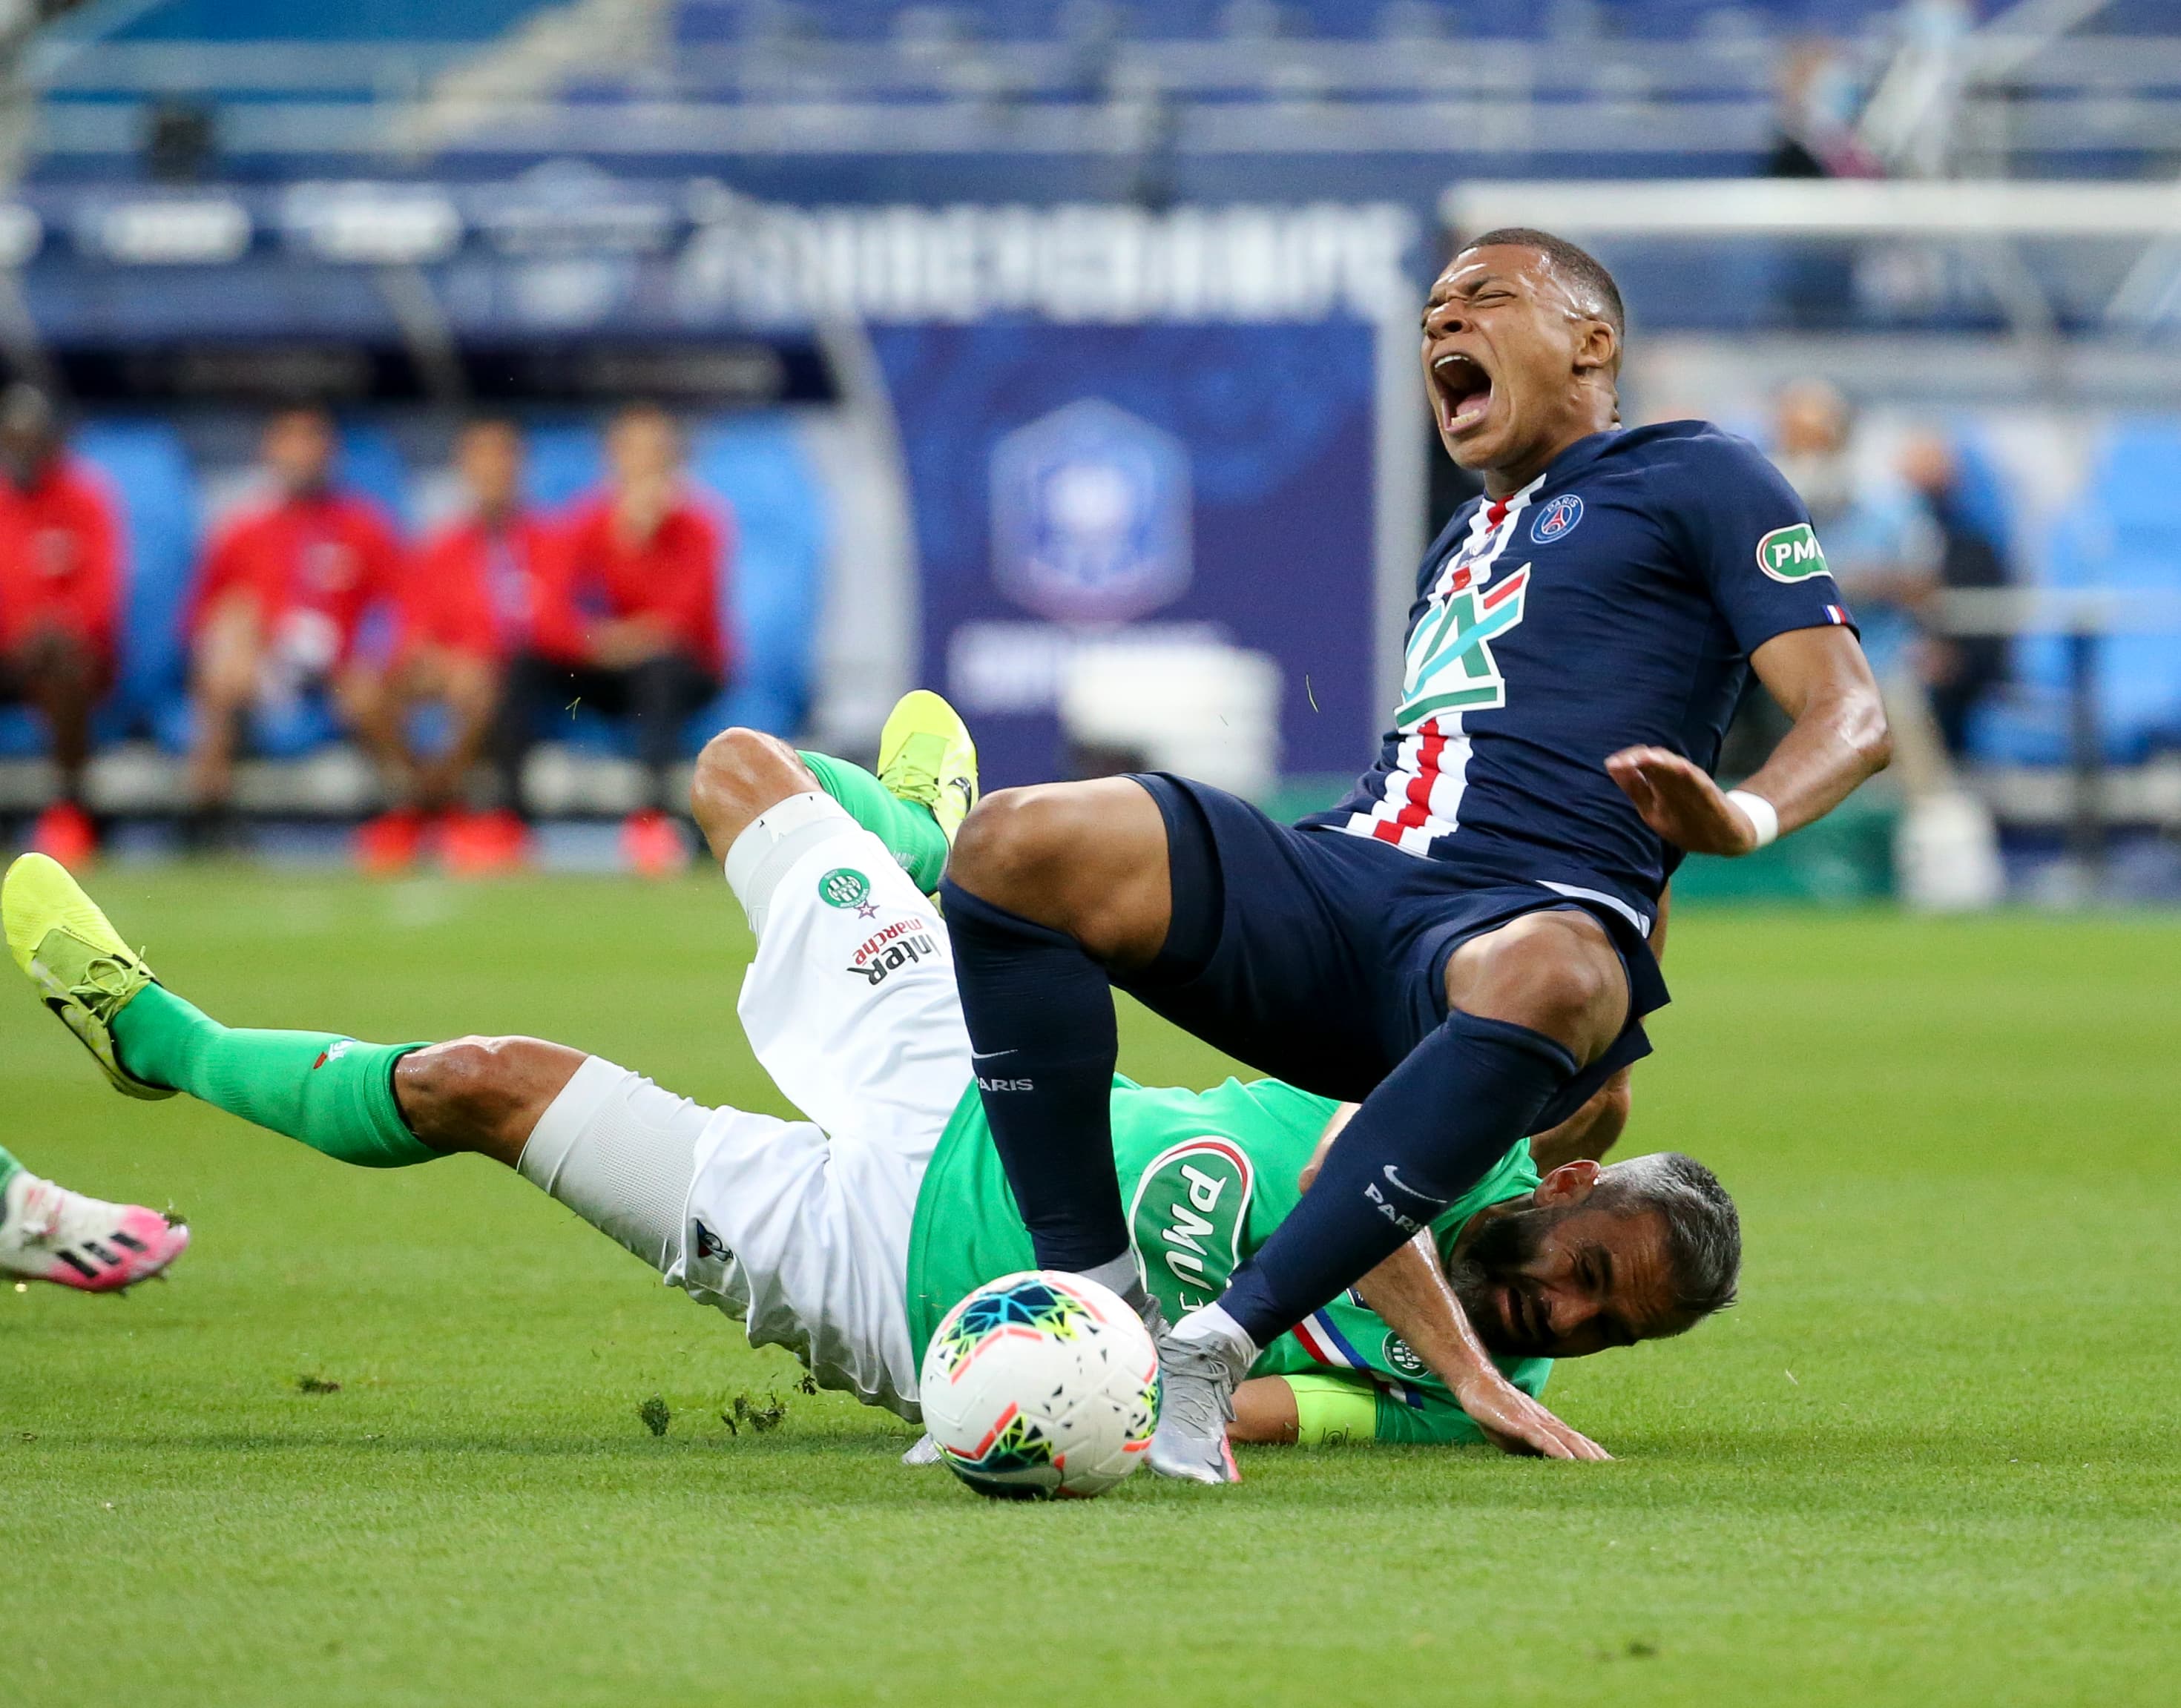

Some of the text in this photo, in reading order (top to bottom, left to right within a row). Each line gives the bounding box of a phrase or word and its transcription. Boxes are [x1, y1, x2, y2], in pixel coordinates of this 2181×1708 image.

[1547, 497, 1579, 512] PARIS
[976, 1077, 1033, 1092] ARIS
[1364, 1182, 1422, 1233] PARI
[1162, 1164, 1227, 1291] PMU
